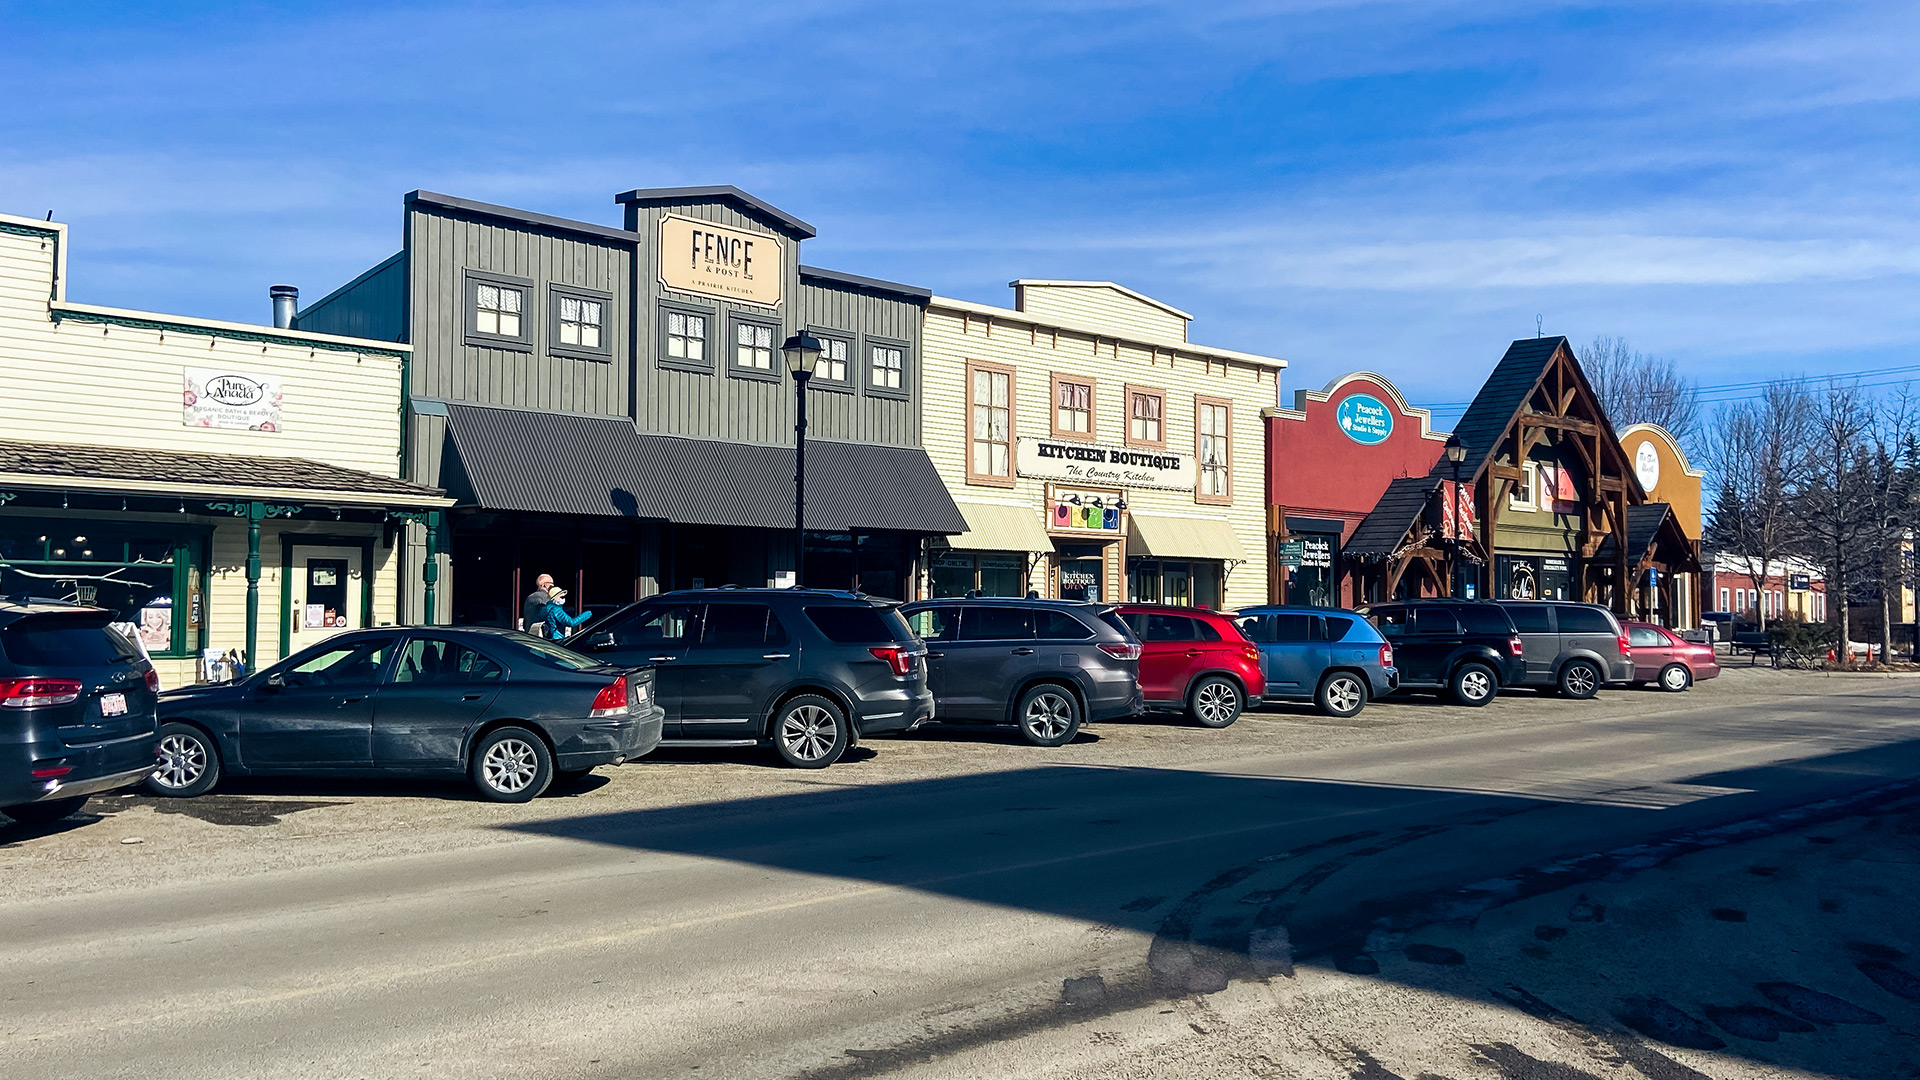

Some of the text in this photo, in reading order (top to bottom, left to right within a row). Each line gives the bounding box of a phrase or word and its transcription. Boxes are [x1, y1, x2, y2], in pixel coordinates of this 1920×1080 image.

[691, 229, 754, 281] FENCE
[705, 265, 740, 278] & POST
[698, 280, 723, 290] PRAIRIE
[726, 286, 754, 295] KITCHEN
[217, 378, 246, 391] Pure
[193, 406, 223, 414] ORGANIC
[225, 407, 242, 415] BATH
[1356, 402, 1384, 416] Peacock
[1354, 413, 1385, 427] Jewellers
[1352, 424, 1367, 433] Studio
[1371, 427, 1387, 436] Supply
[1037, 443, 1180, 471] KITCHEN BOUTIQUE
[1065, 464, 1155, 483] The Country Kitchen
[1304, 541, 1329, 550] Peacock
[1302, 550, 1331, 560] Jewellers
[1063, 571, 1094, 579] KITCHEN
